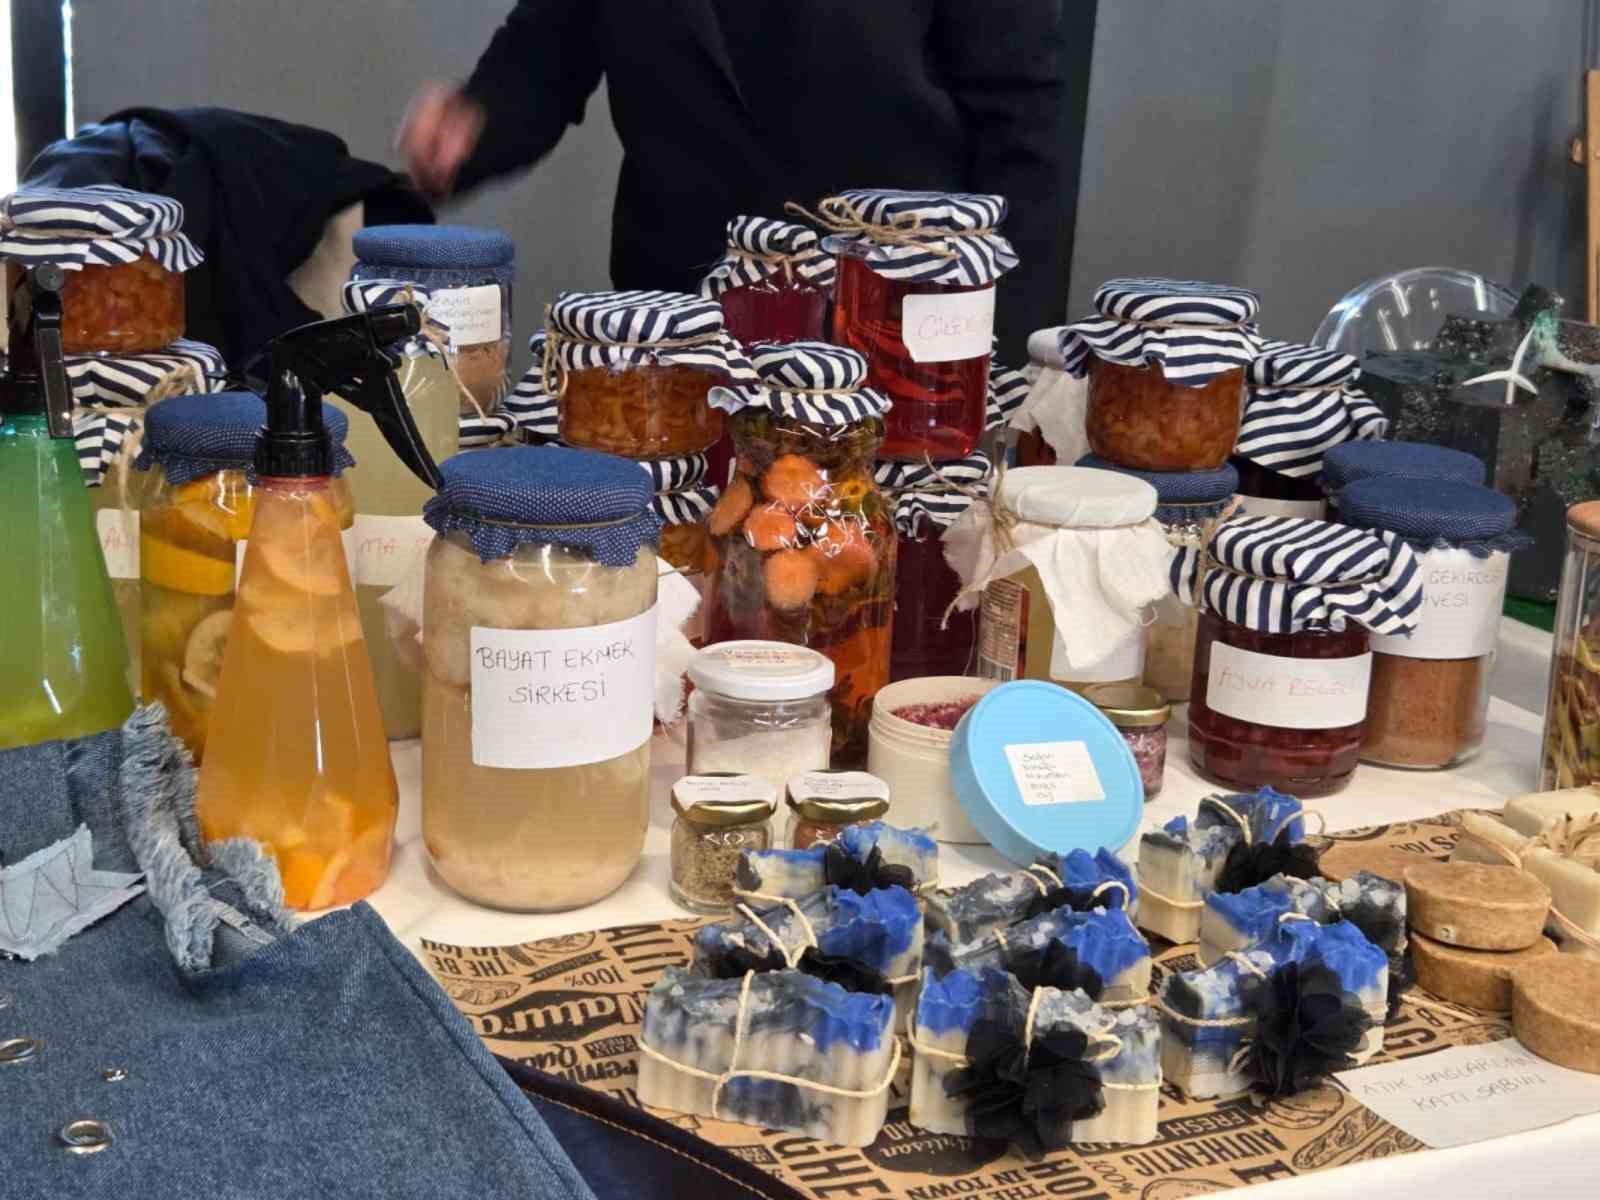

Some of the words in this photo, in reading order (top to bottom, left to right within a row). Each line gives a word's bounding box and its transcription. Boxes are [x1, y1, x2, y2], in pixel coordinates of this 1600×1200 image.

[476, 646, 552, 671] BAYAT
[564, 637, 638, 670] EKMEK
[508, 672, 608, 705] SİRKESİ
[463, 957, 513, 977] THE
[562, 964, 625, 987] 100%
[1165, 1109, 1247, 1137] FRESH
[1121, 1128, 1288, 1177] AUTHENTIC
[905, 1175, 995, 1200] TOWN
[992, 1168, 1027, 1186] IN
